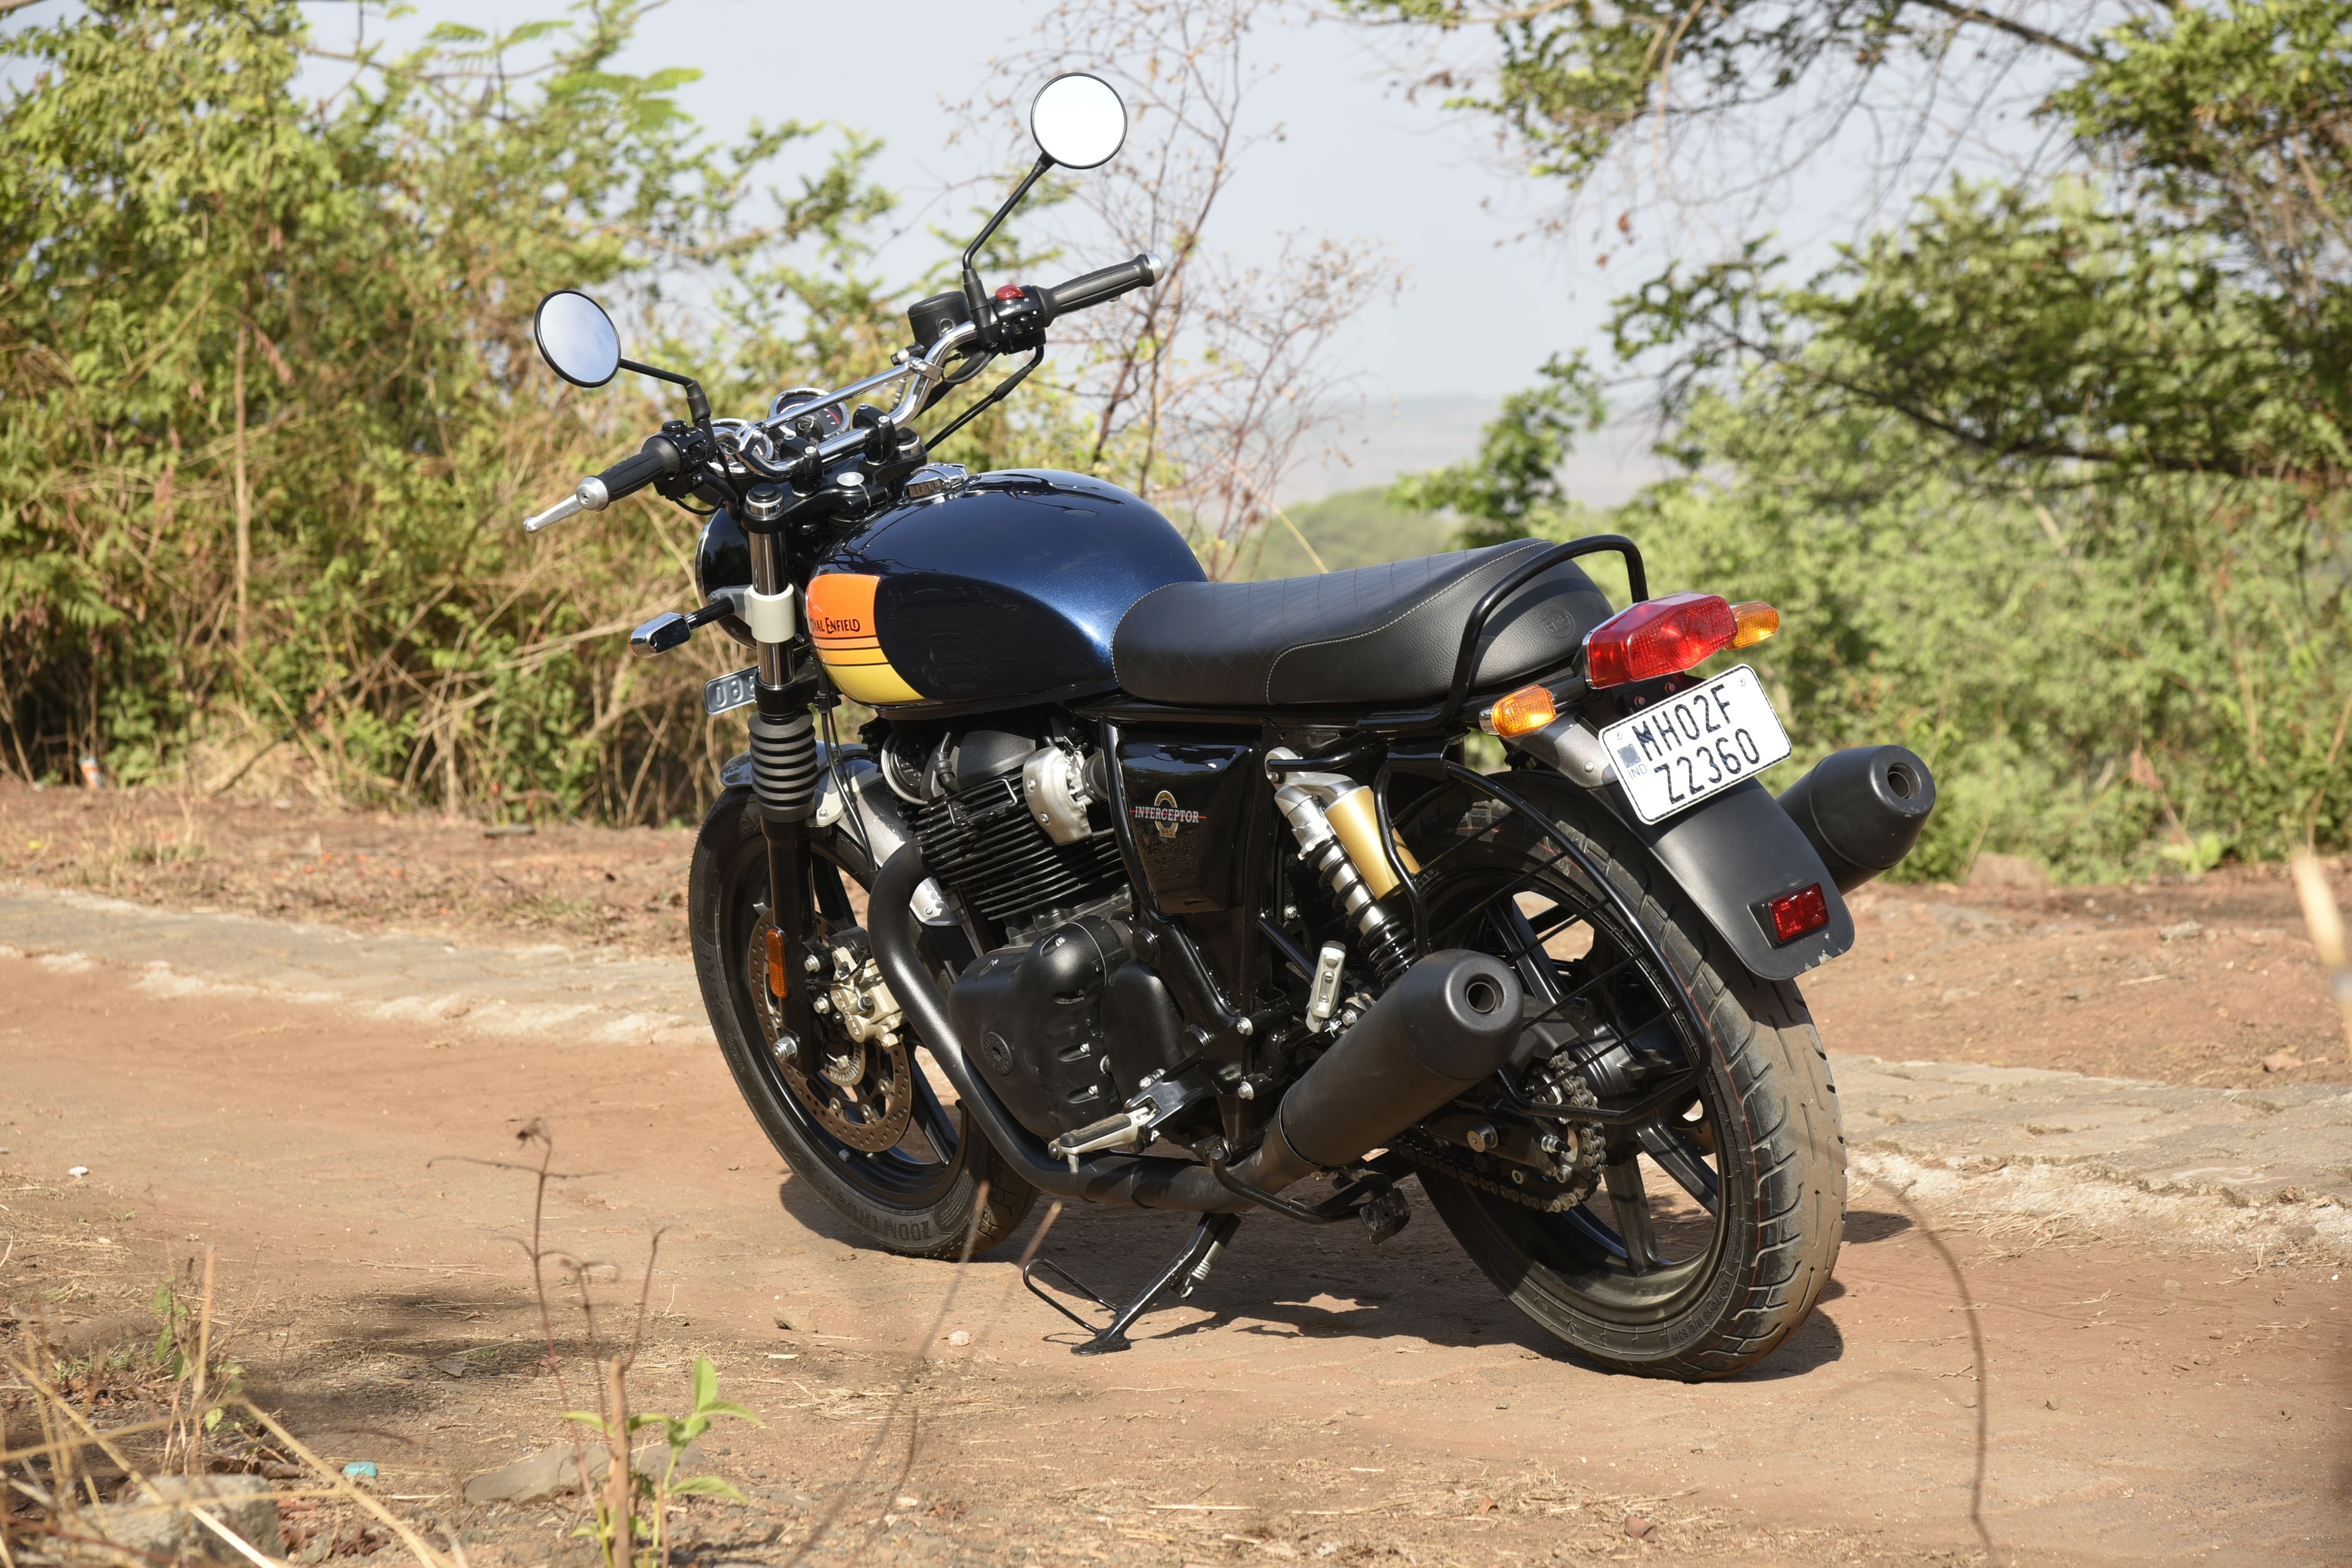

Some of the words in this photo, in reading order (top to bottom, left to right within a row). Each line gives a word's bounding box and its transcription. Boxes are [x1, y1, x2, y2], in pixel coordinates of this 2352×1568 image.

[825, 617, 860, 634] ENFIELD
[1632, 683, 1731, 761] MH02F
[1627, 763, 1648, 780] IND
[1653, 728, 1760, 804] Z2360
[1134, 806, 1199, 823] INTERCEPTOR
